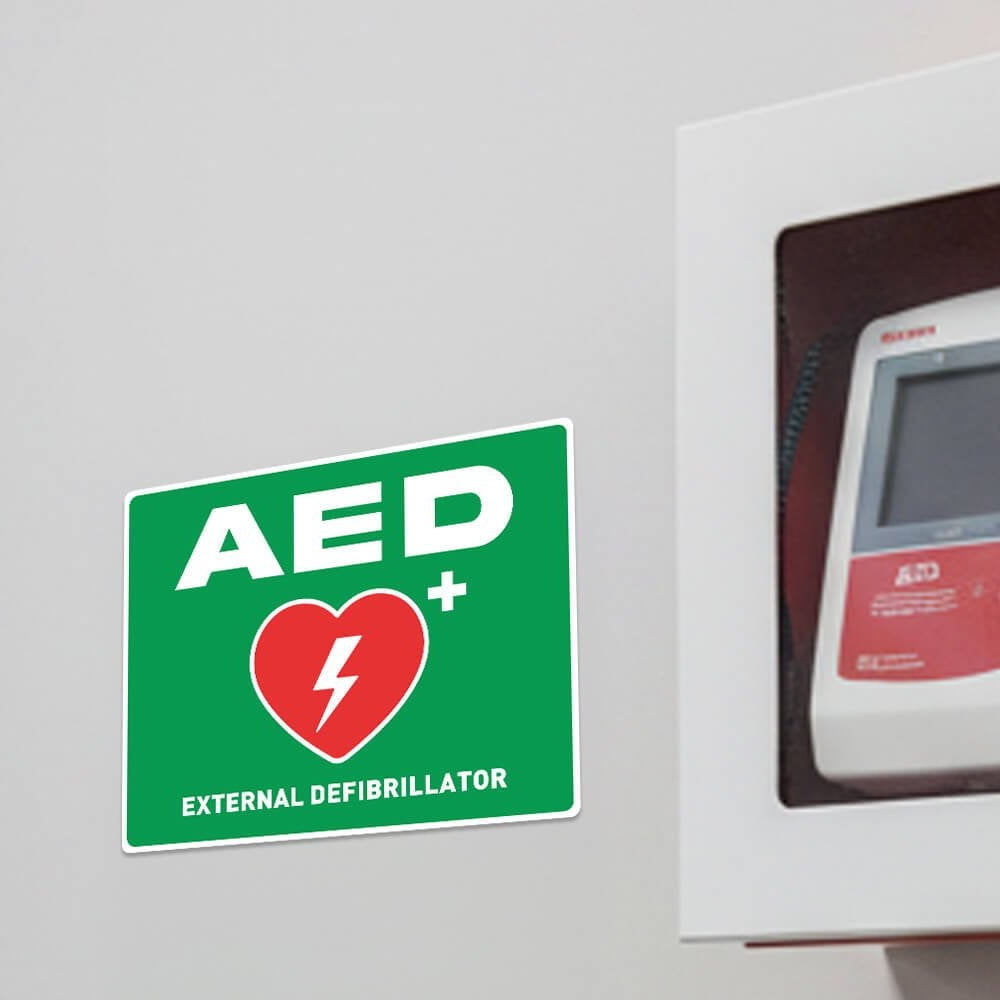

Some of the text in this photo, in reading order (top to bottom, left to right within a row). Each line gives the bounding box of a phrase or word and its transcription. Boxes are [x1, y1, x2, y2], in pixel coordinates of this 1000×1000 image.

[174, 465, 514, 591] AED
[182, 767, 508, 817] EXTERNAL DEFIBRILLATOR
